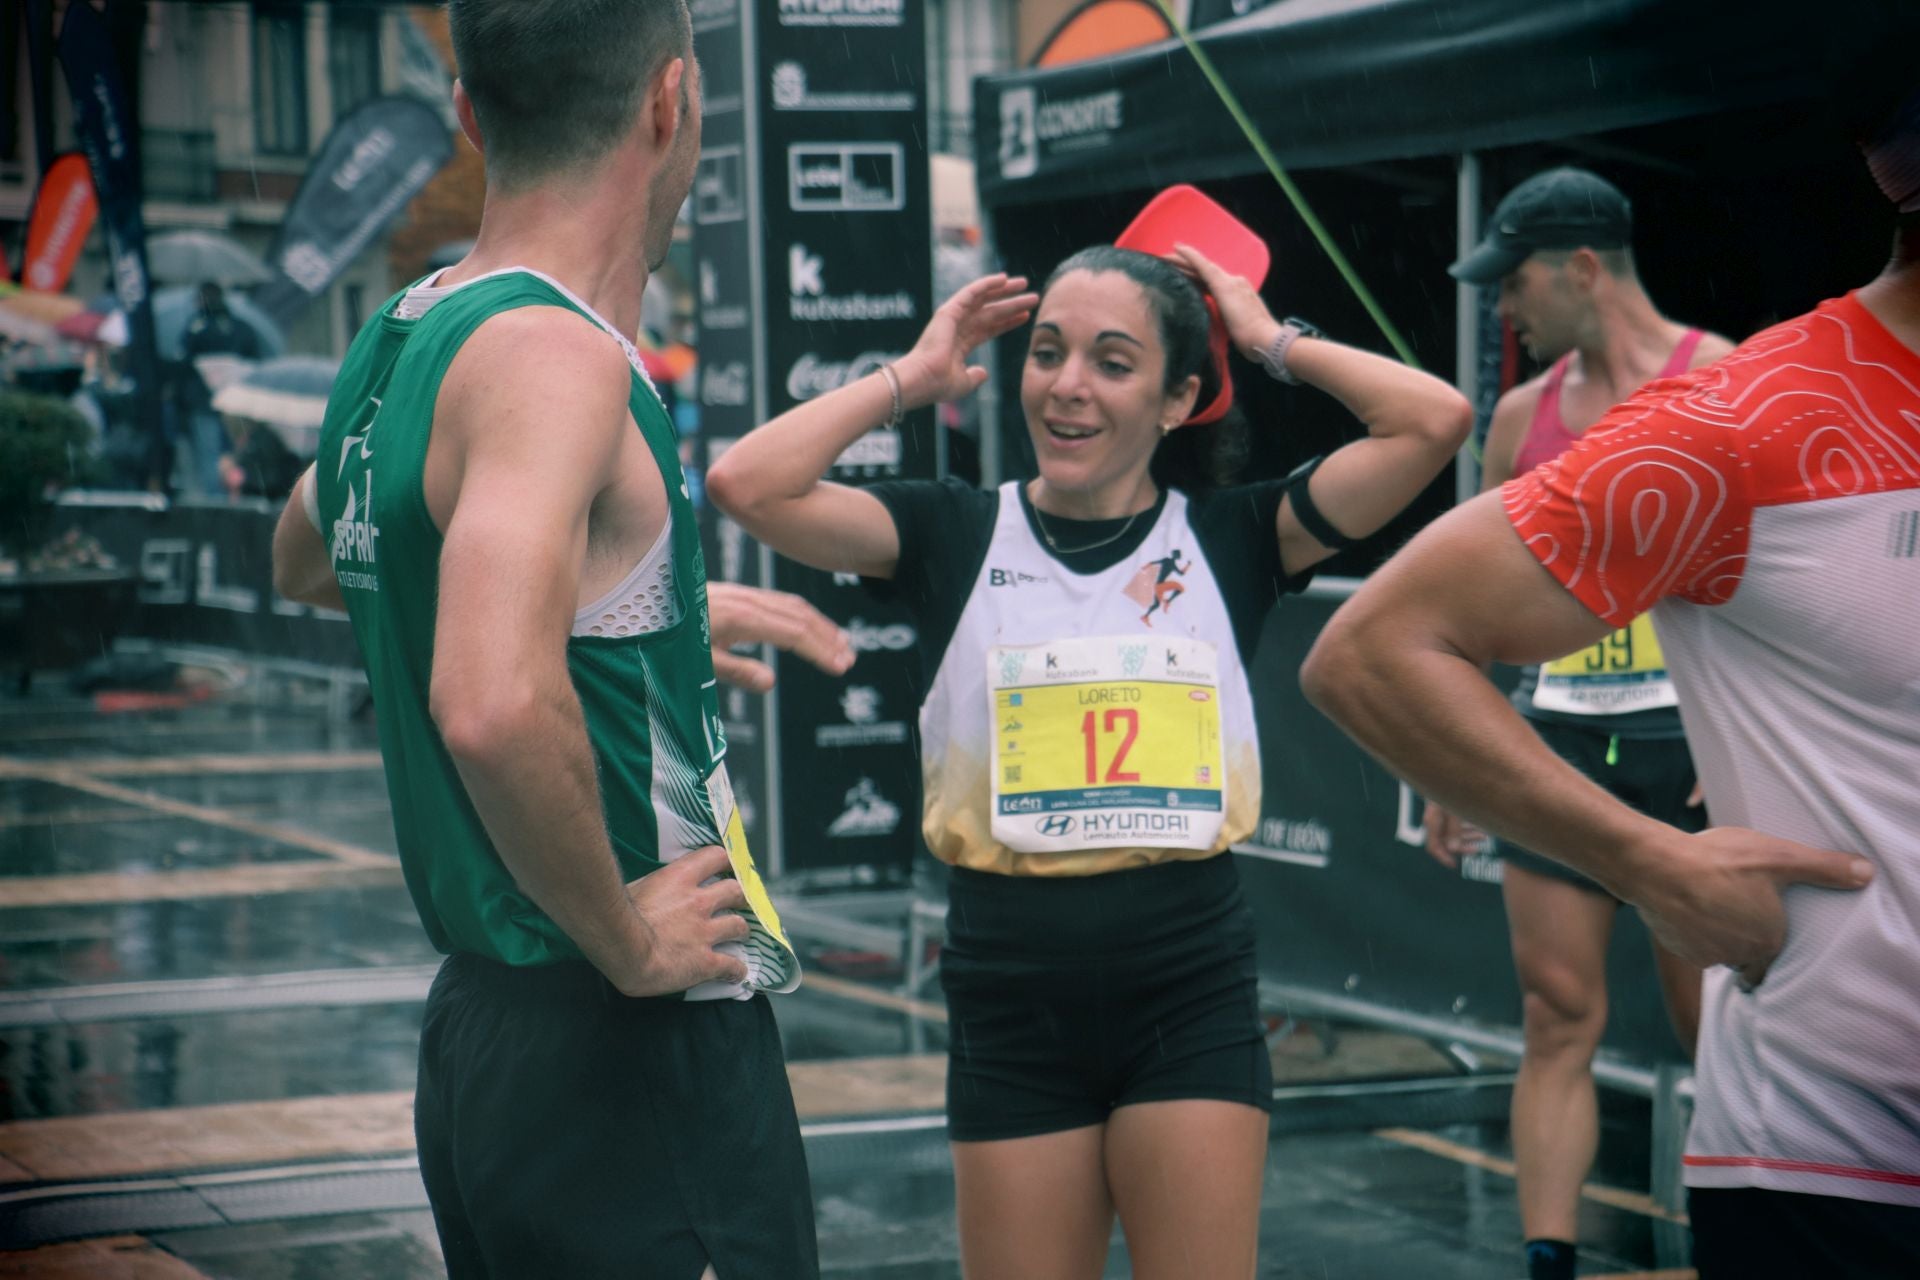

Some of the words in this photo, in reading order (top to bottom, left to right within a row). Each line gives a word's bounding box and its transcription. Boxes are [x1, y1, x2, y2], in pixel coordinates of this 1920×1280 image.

[1045, 668, 1099, 680] kutxabank
[1078, 687, 1142, 705] LORETO
[1081, 707, 1141, 785] 12
[1083, 813, 1189, 831] HYUNDAI
